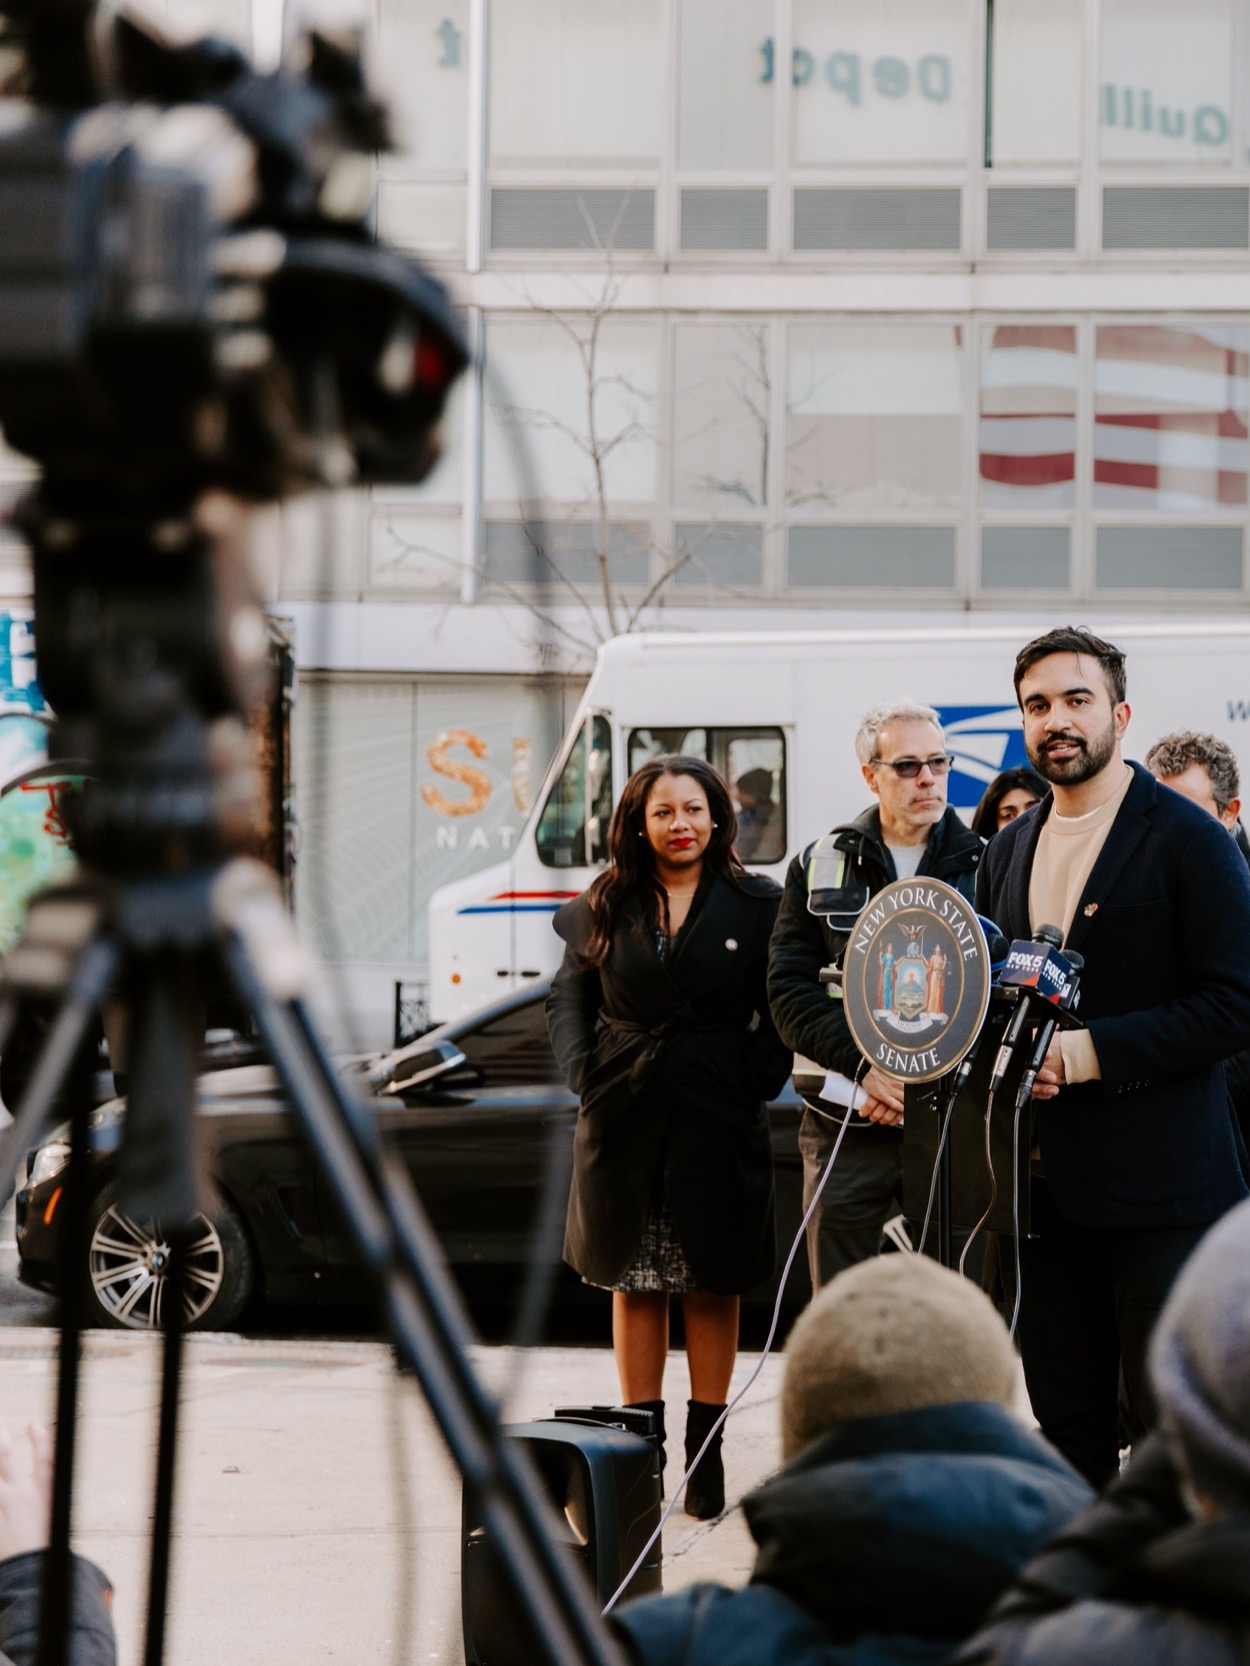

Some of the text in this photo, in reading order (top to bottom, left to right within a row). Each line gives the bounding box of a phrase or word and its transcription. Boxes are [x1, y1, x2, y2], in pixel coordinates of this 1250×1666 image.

[855, 887, 978, 961] NEW YORK STATE
[876, 1043, 940, 1073] SENATE
